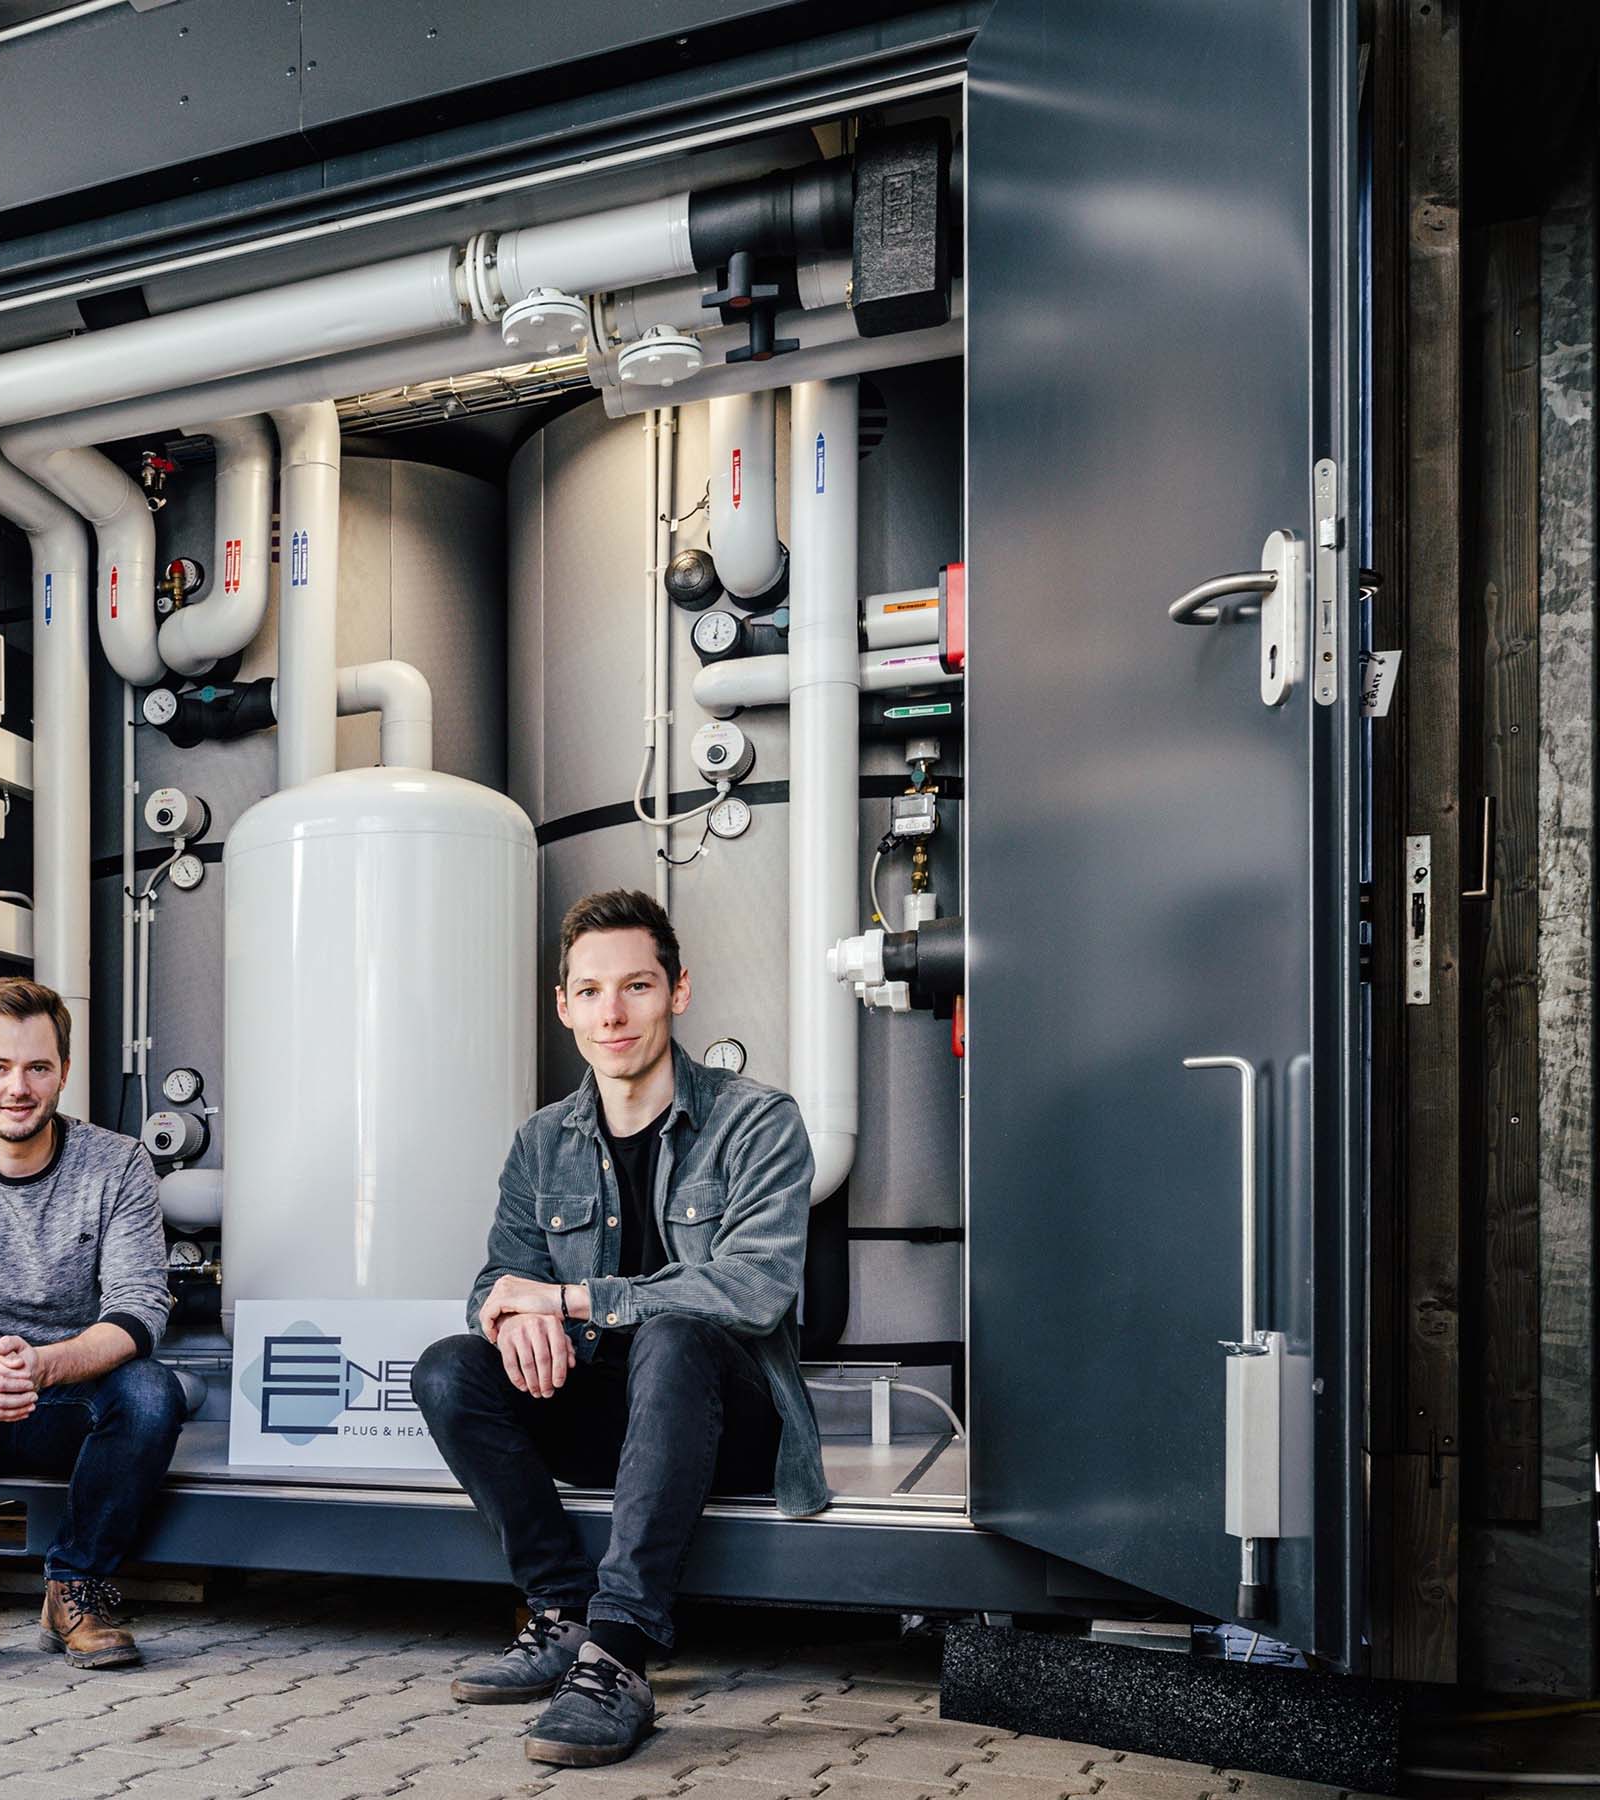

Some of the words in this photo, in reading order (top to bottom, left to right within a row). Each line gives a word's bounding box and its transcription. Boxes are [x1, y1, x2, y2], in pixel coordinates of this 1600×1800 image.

[263, 1336, 417, 1383] ENE
[343, 1425, 378, 1436] PLUG
[383, 1426, 392, 1436] &
